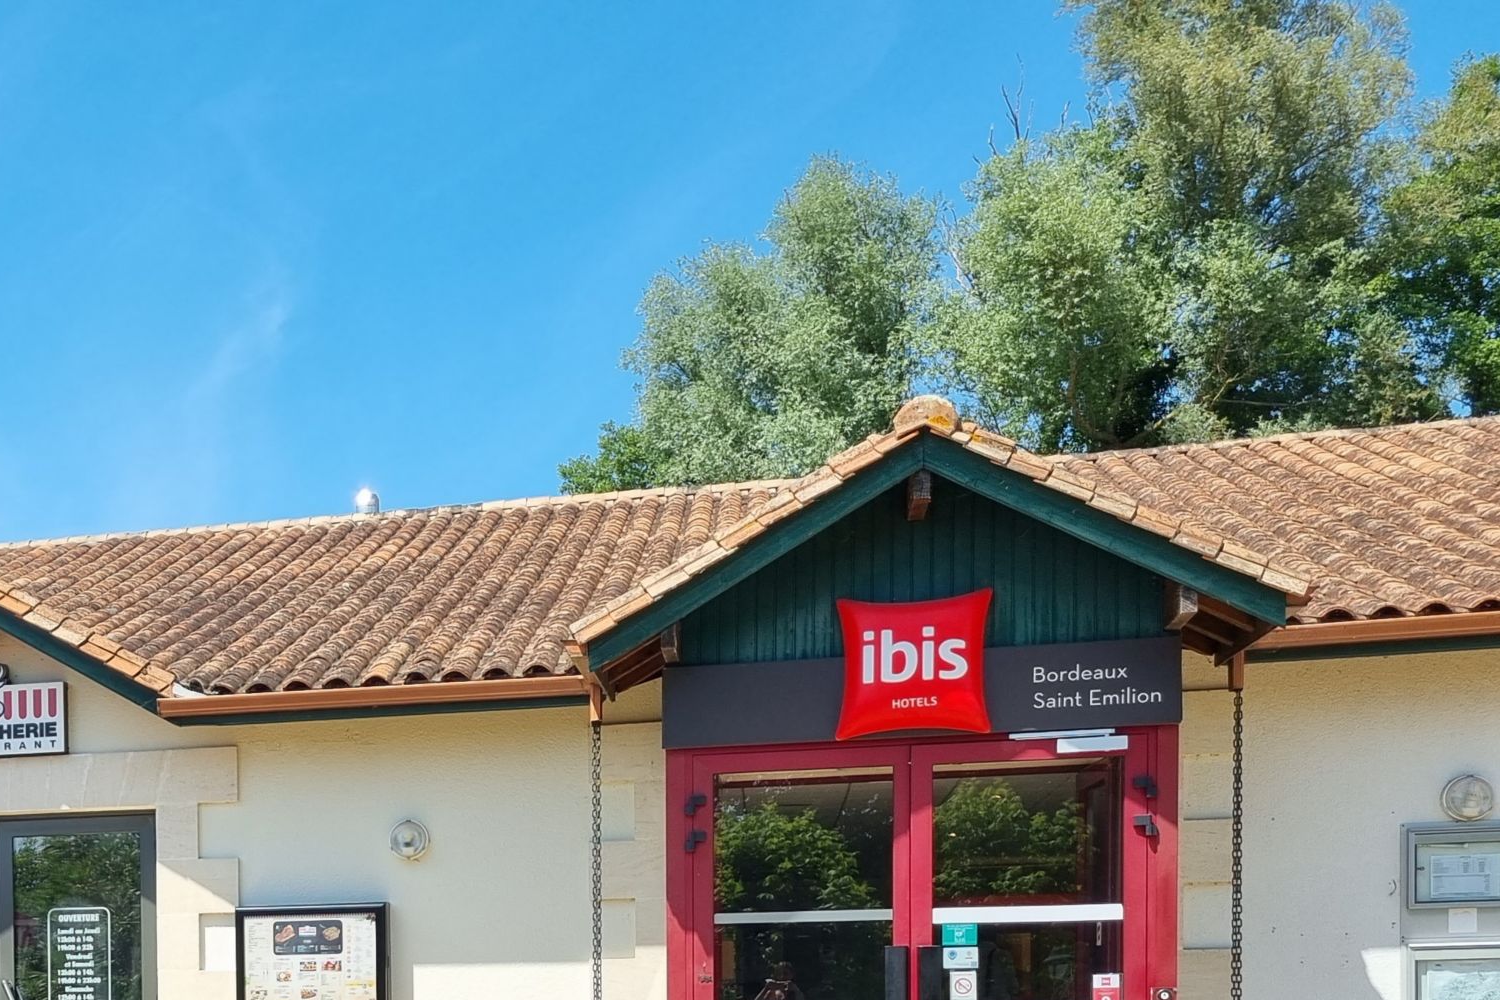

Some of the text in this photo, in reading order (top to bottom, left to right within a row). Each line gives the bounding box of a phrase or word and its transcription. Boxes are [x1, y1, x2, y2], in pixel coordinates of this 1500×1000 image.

[862, 626, 968, 684] ibis
[1033, 664, 1128, 684] Bordeaux
[892, 696, 937, 709] HOTELS
[1033, 687, 1162, 709] Saint Emilion
[58, 914, 100, 922] OUVERTURE
